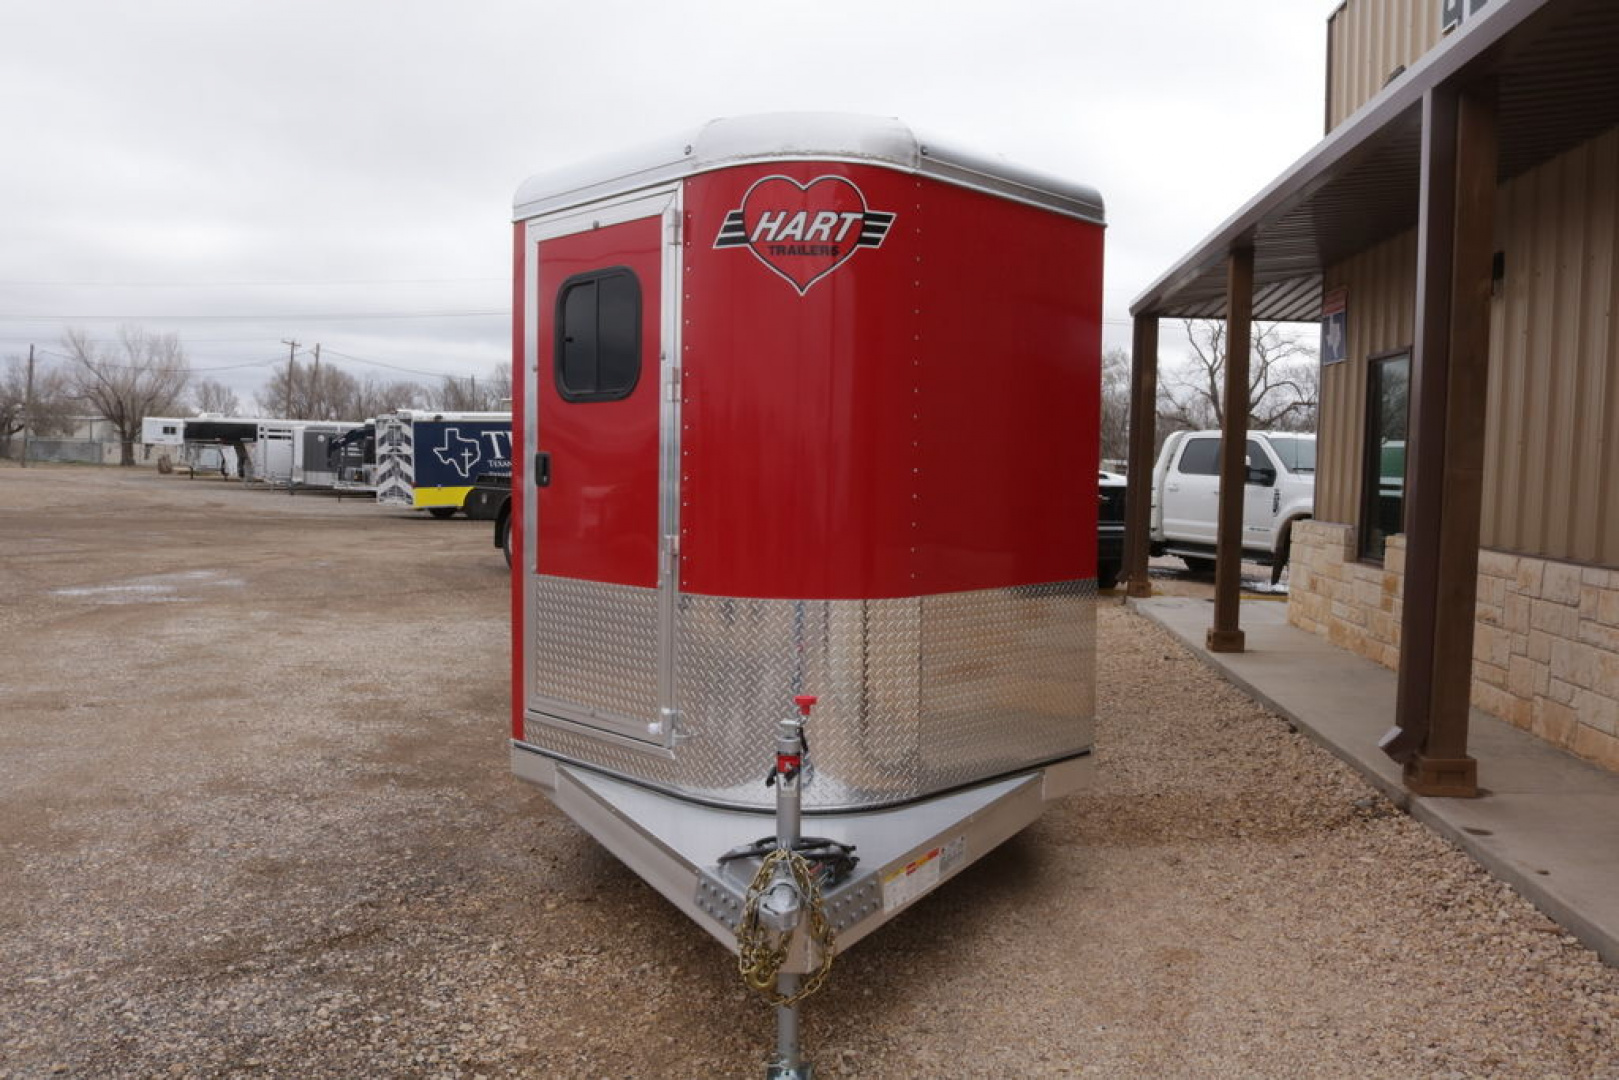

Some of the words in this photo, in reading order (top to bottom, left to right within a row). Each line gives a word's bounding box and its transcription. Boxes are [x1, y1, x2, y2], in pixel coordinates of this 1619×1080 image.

[751, 211, 864, 242] HART
[768, 245, 840, 256] TRAILERS
[481, 431, 512, 459] T
